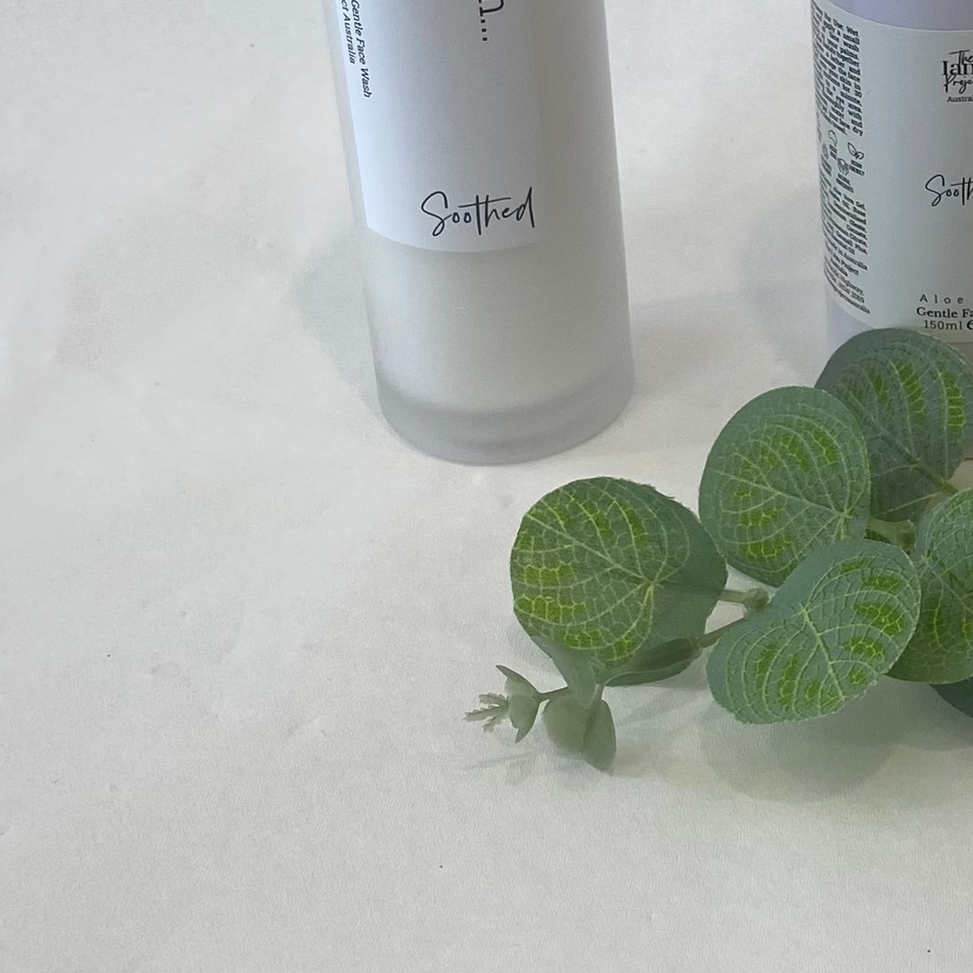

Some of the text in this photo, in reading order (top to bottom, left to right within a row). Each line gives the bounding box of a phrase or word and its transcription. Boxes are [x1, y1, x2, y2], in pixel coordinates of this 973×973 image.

[351, 0, 363, 36] Gentle
[343, 13, 357, 65] Australia
[355, 37, 367, 65] Face
[360, 68, 372, 98] Wash
[421, 187, 536, 237] Soothed
[916, 307, 958, 318] Gentle
[919, 293, 964, 304] Aloe
[924, 320, 963, 330] 150ml
